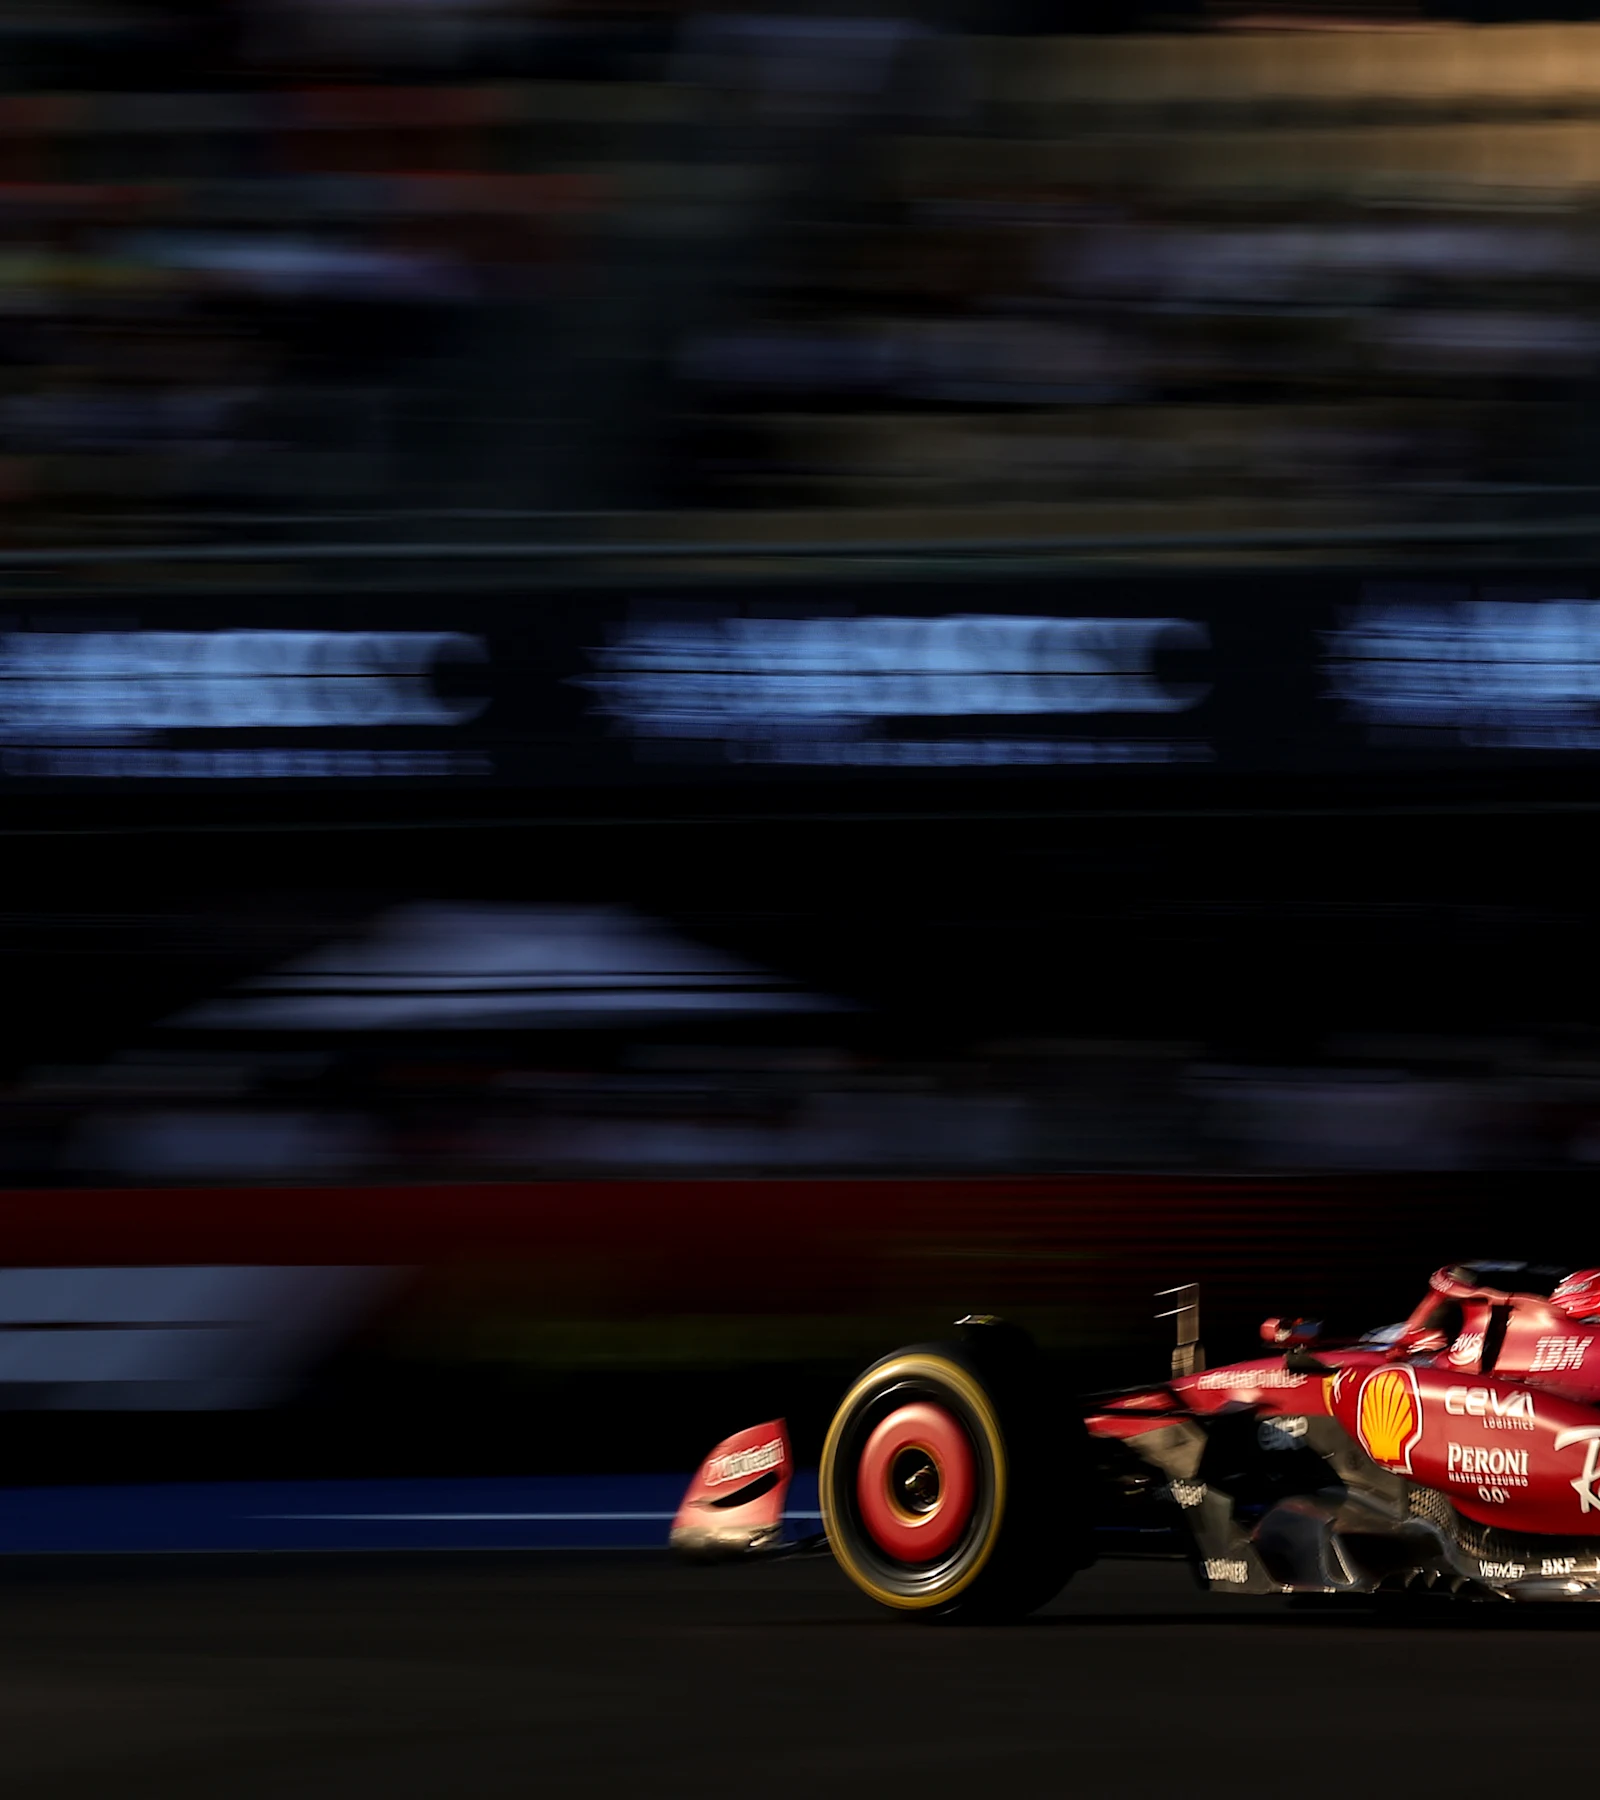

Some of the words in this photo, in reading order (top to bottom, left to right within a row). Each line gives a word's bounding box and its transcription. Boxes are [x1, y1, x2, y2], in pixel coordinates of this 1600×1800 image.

[1528, 1335, 1596, 1373] IBM
[1444, 1385, 1536, 1418] CEVA
[1483, 1416, 1535, 1431] LOGISTICS
[1447, 1441, 1530, 1476] PERONI
[1448, 1472, 1484, 1485] NASTRO
[1485, 1474, 1529, 1487] AZZURRO
